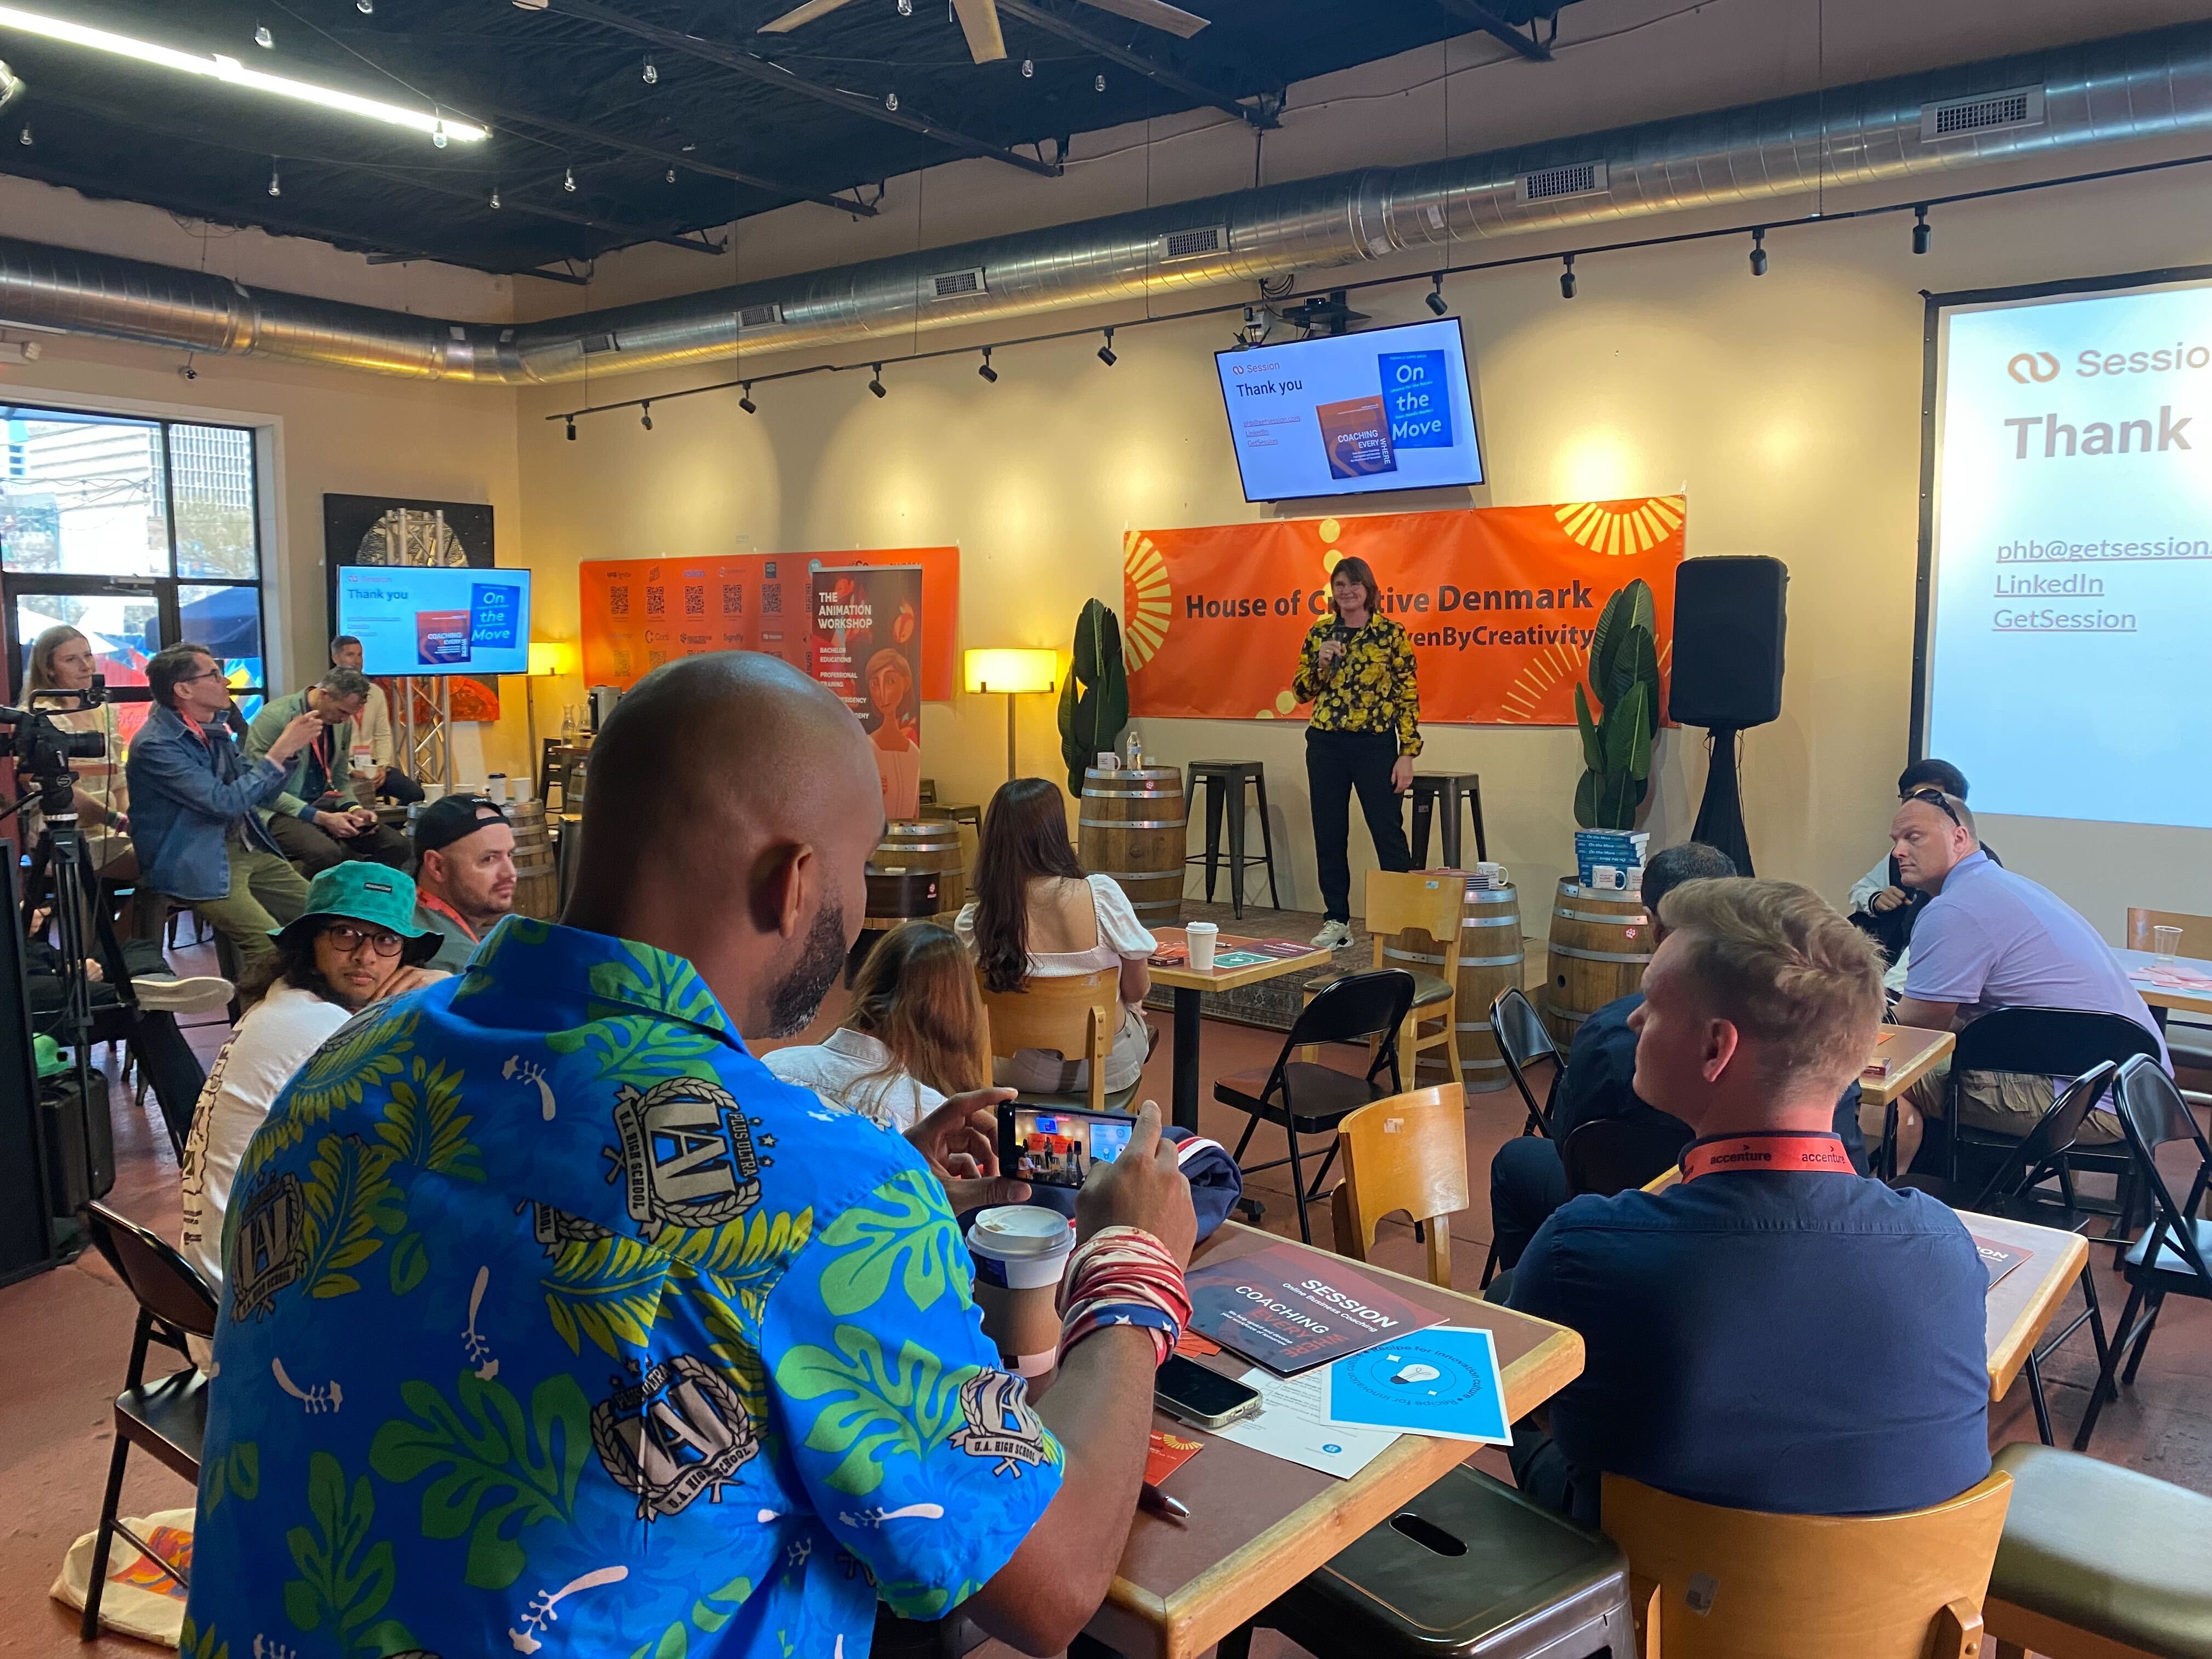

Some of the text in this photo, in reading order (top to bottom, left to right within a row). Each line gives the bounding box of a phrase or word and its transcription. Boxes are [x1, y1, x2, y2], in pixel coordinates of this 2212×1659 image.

[1247, 362, 1280, 374] Session
[1396, 365, 1424, 383] On
[1236, 380, 1303, 397] Thank you
[1396, 392, 1429, 411] the
[1245, 428, 1269, 437] LinkedIn
[1338, 430, 1378, 443] COACHING
[1392, 420, 1442, 441] Move
[2004, 405, 2193, 460] Thank
[1248, 439, 1278, 448] GetSession
[1358, 439, 1379, 448] EVERY
[1380, 438, 1391, 465] WHERE
[1995, 573, 2103, 595] LinkedIn
[347, 588, 409, 601] Thank you
[483, 592, 505, 605] On
[819, 592, 838, 602] THE
[1186, 594, 1267, 619] House
[1274, 589, 1301, 615] of
[1438, 580, 1594, 612] Denmark
[479, 611, 505, 623] the
[819, 605, 871, 616] ANIMATION
[817, 618, 872, 629] WORKSHOP
[1993, 609, 2137, 630] GetSession
[471, 629, 510, 641] Move
[729, 1113, 758, 1177] PLUS ULTRA
[619, 1110, 647, 1209] U.A. HIGH SCHOOL
[1710, 1152, 1771, 1164] accenture
[1802, 1152, 1845, 1164] accenture
[1235, 1286, 1330, 1334] COACHING
[1282, 1283, 1379, 1333] Online Business Coaching
[1301, 1280, 1398, 1328] SESSION
[1251, 1307, 1314, 1339] EVERY
[1263, 1333, 1288, 1345] tomorrow
[1272, 1334, 1293, 1344] develop
[1279, 1333, 1350, 1358] WHERE
[642, 1364, 668, 1395] ULTRA
[1435, 1351, 1480, 1379] innovation
[1462, 1379, 1484, 1399] culture
[1347, 1372, 1391, 1402] innovation
[1394, 1397, 1410, 1406] for
[974, 1441, 1035, 1462] U.A. HIGH SCHOOL
[668, 1492, 692, 1509] U.A.
